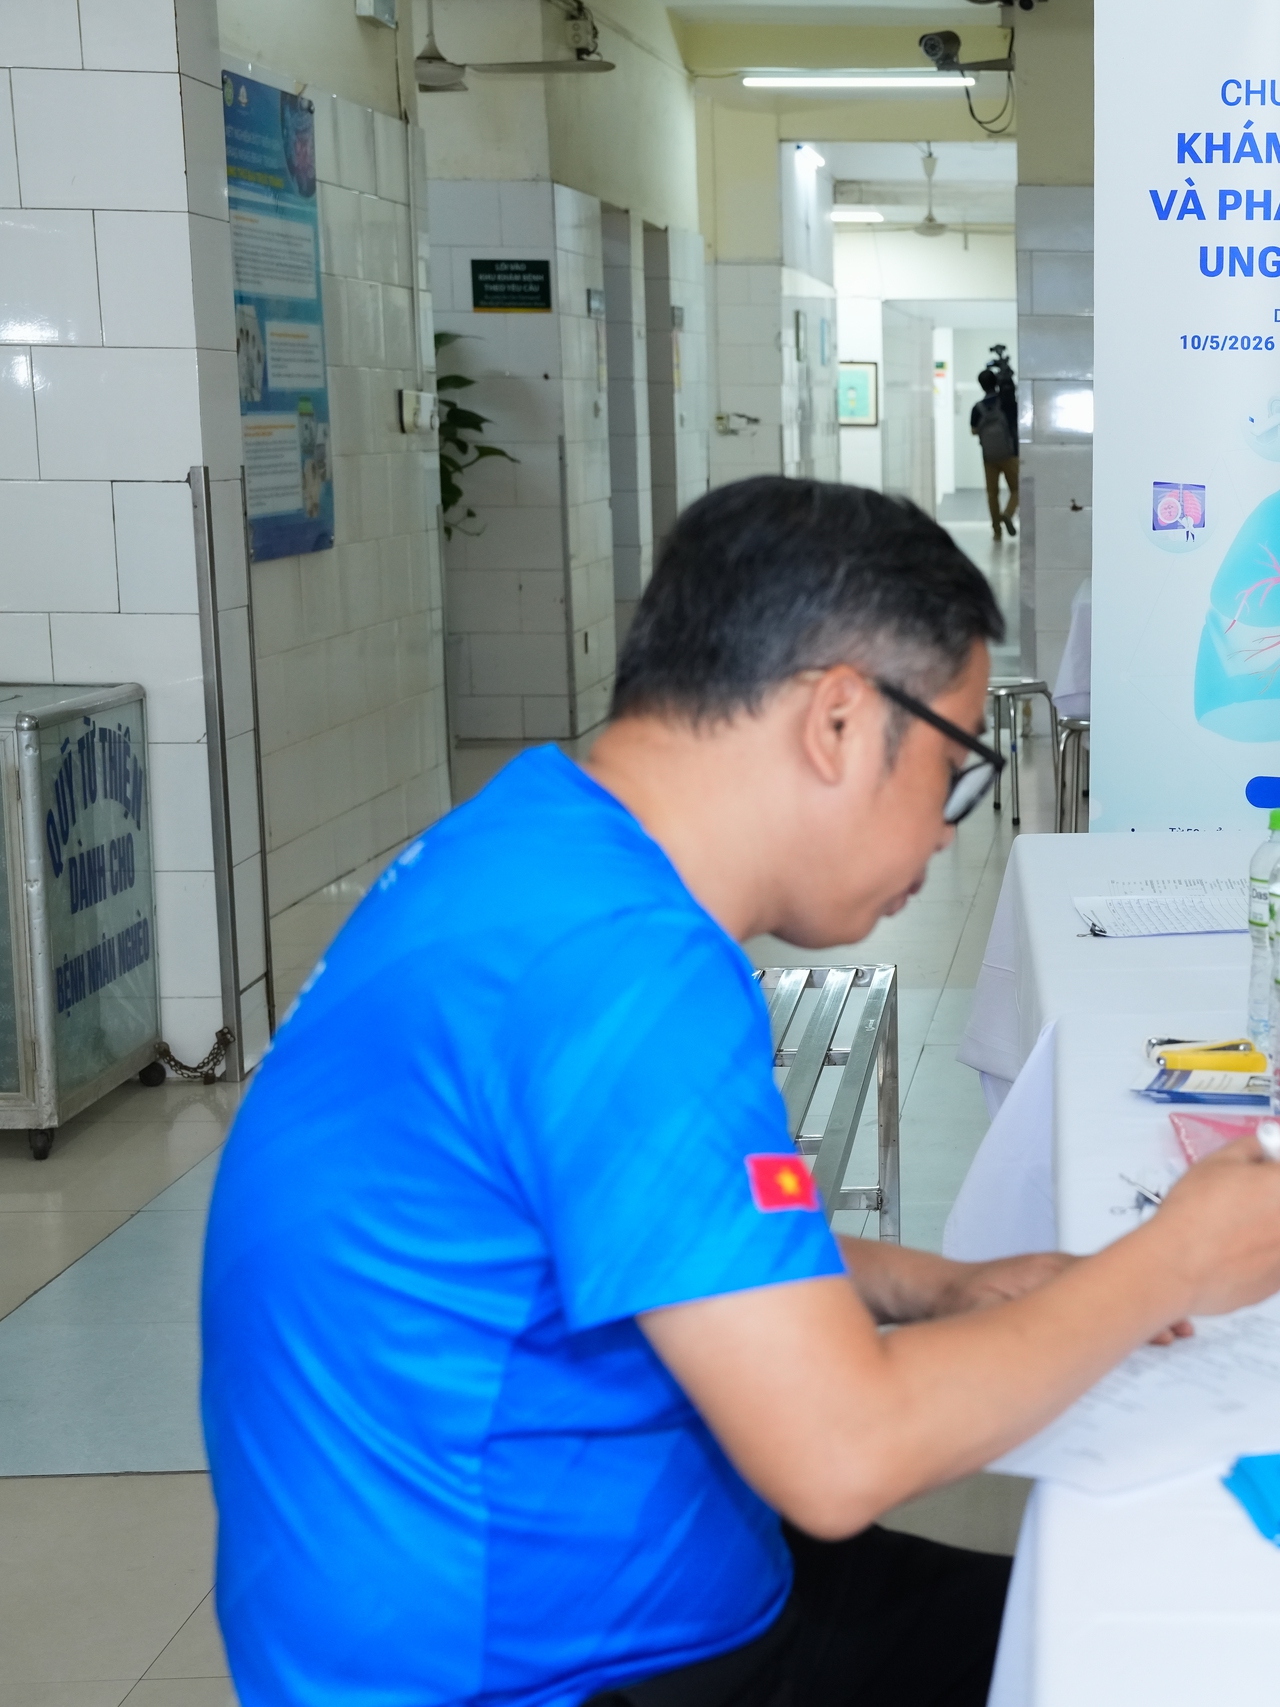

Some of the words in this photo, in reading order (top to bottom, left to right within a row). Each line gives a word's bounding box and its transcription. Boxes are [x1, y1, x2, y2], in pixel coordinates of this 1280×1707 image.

[1149, 176, 1207, 221] VÀ
[1180, 335, 1275, 351] 10/5/2026
[46, 736, 77, 878] QUỸ
[77, 715, 98, 811] TỪ
[98, 722, 143, 832] THIỆN
[68, 838, 107, 915] DÀNH
[109, 832, 135, 896] CHO
[56, 953, 86, 1018] BỆNH
[87, 932, 117, 995] NHÂN
[117, 908, 150, 978] NGHÈO
